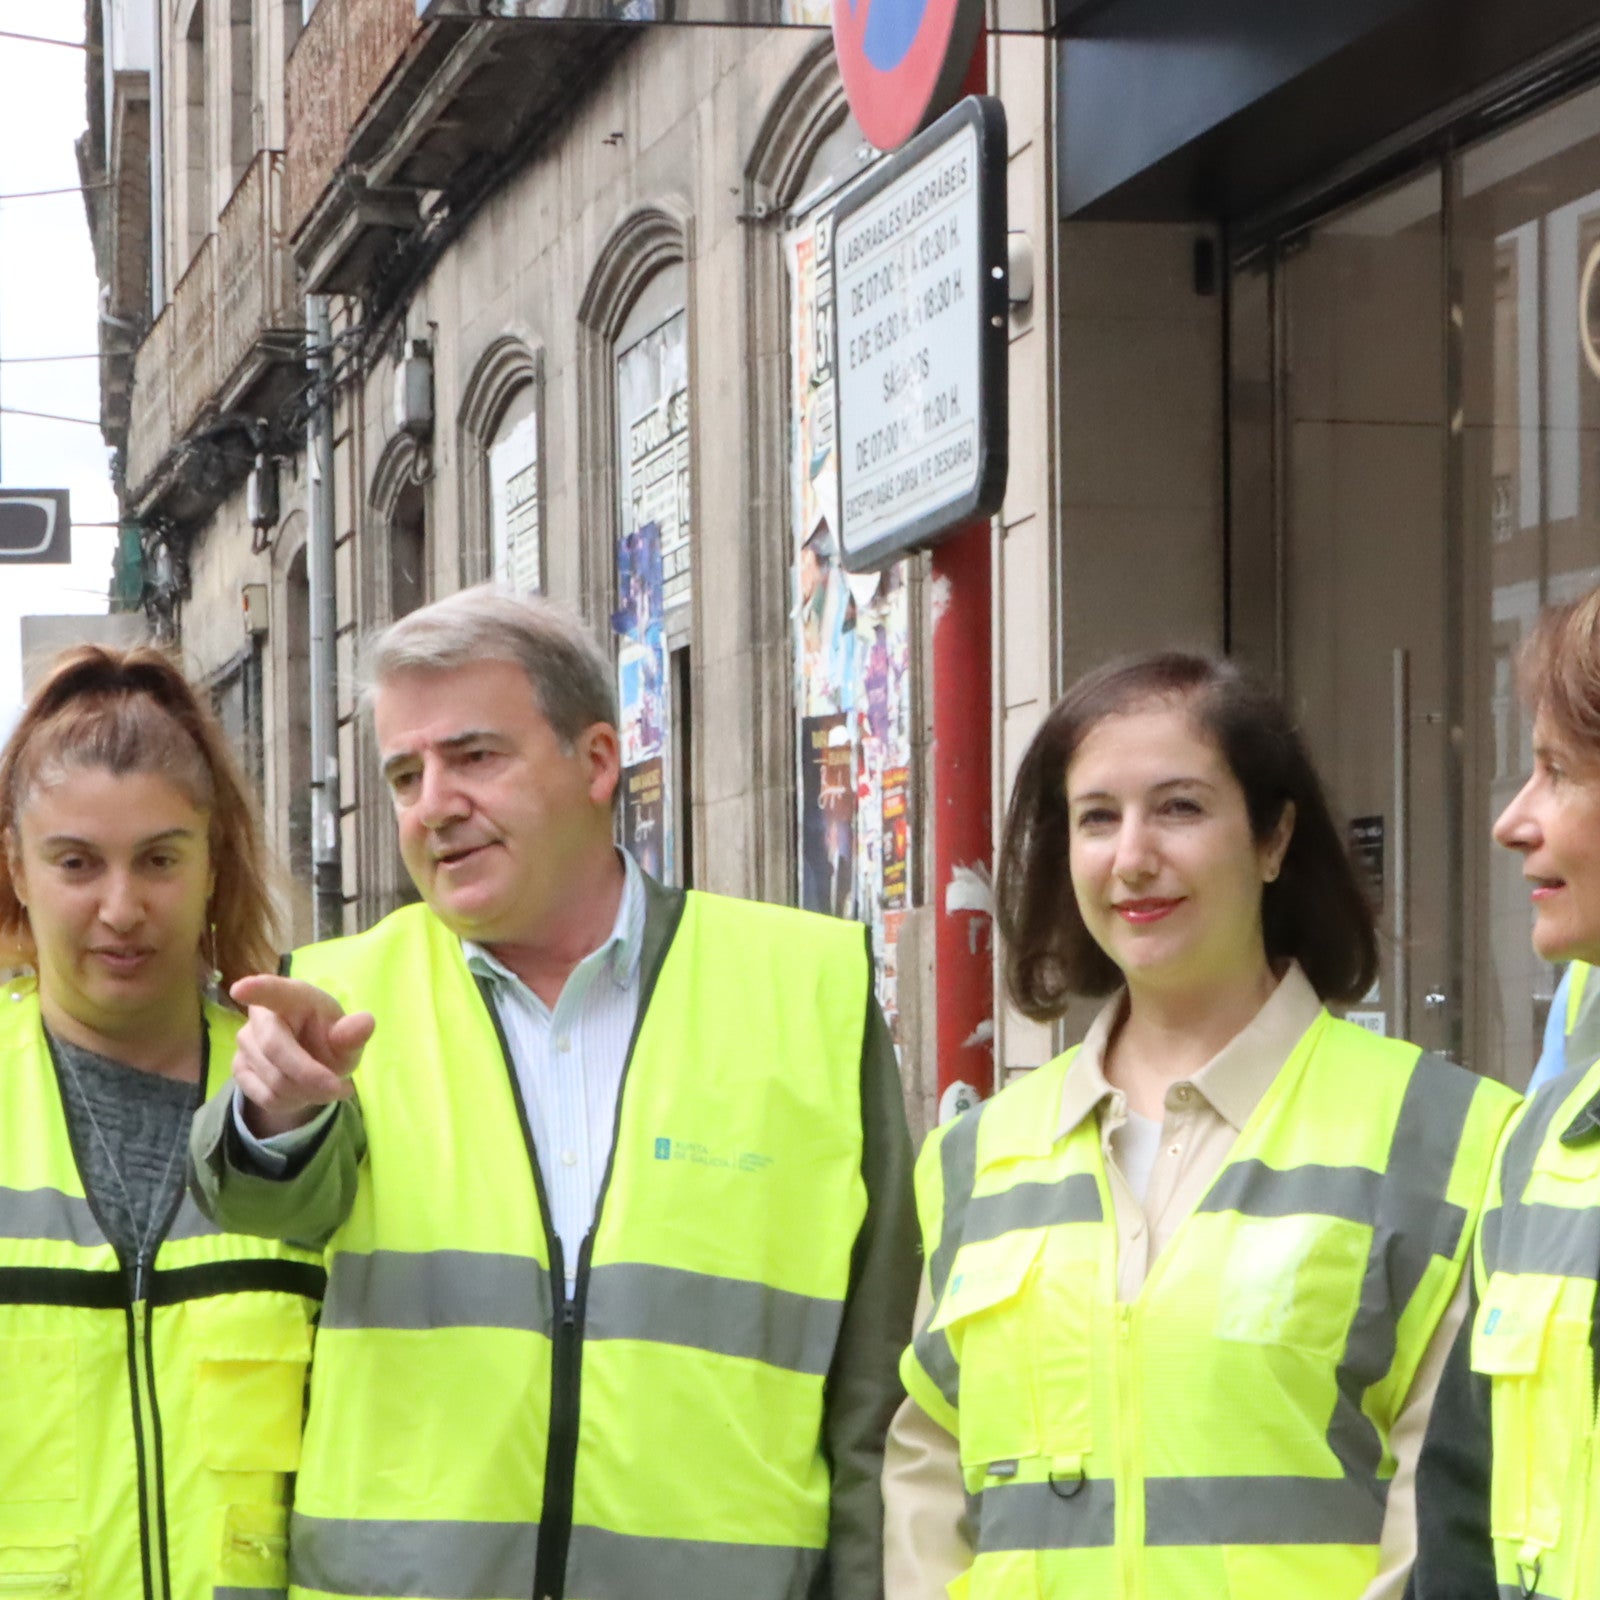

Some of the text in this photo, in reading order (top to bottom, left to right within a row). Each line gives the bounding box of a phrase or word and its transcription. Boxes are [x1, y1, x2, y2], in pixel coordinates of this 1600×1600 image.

[851, 281, 864, 318] DE
[919, 223, 946, 270] 13:30
[849, 339, 855, 371] E
[858, 328, 870, 366] DE
[855, 436, 868, 473] DE
[870, 417, 897, 465] 07:00
